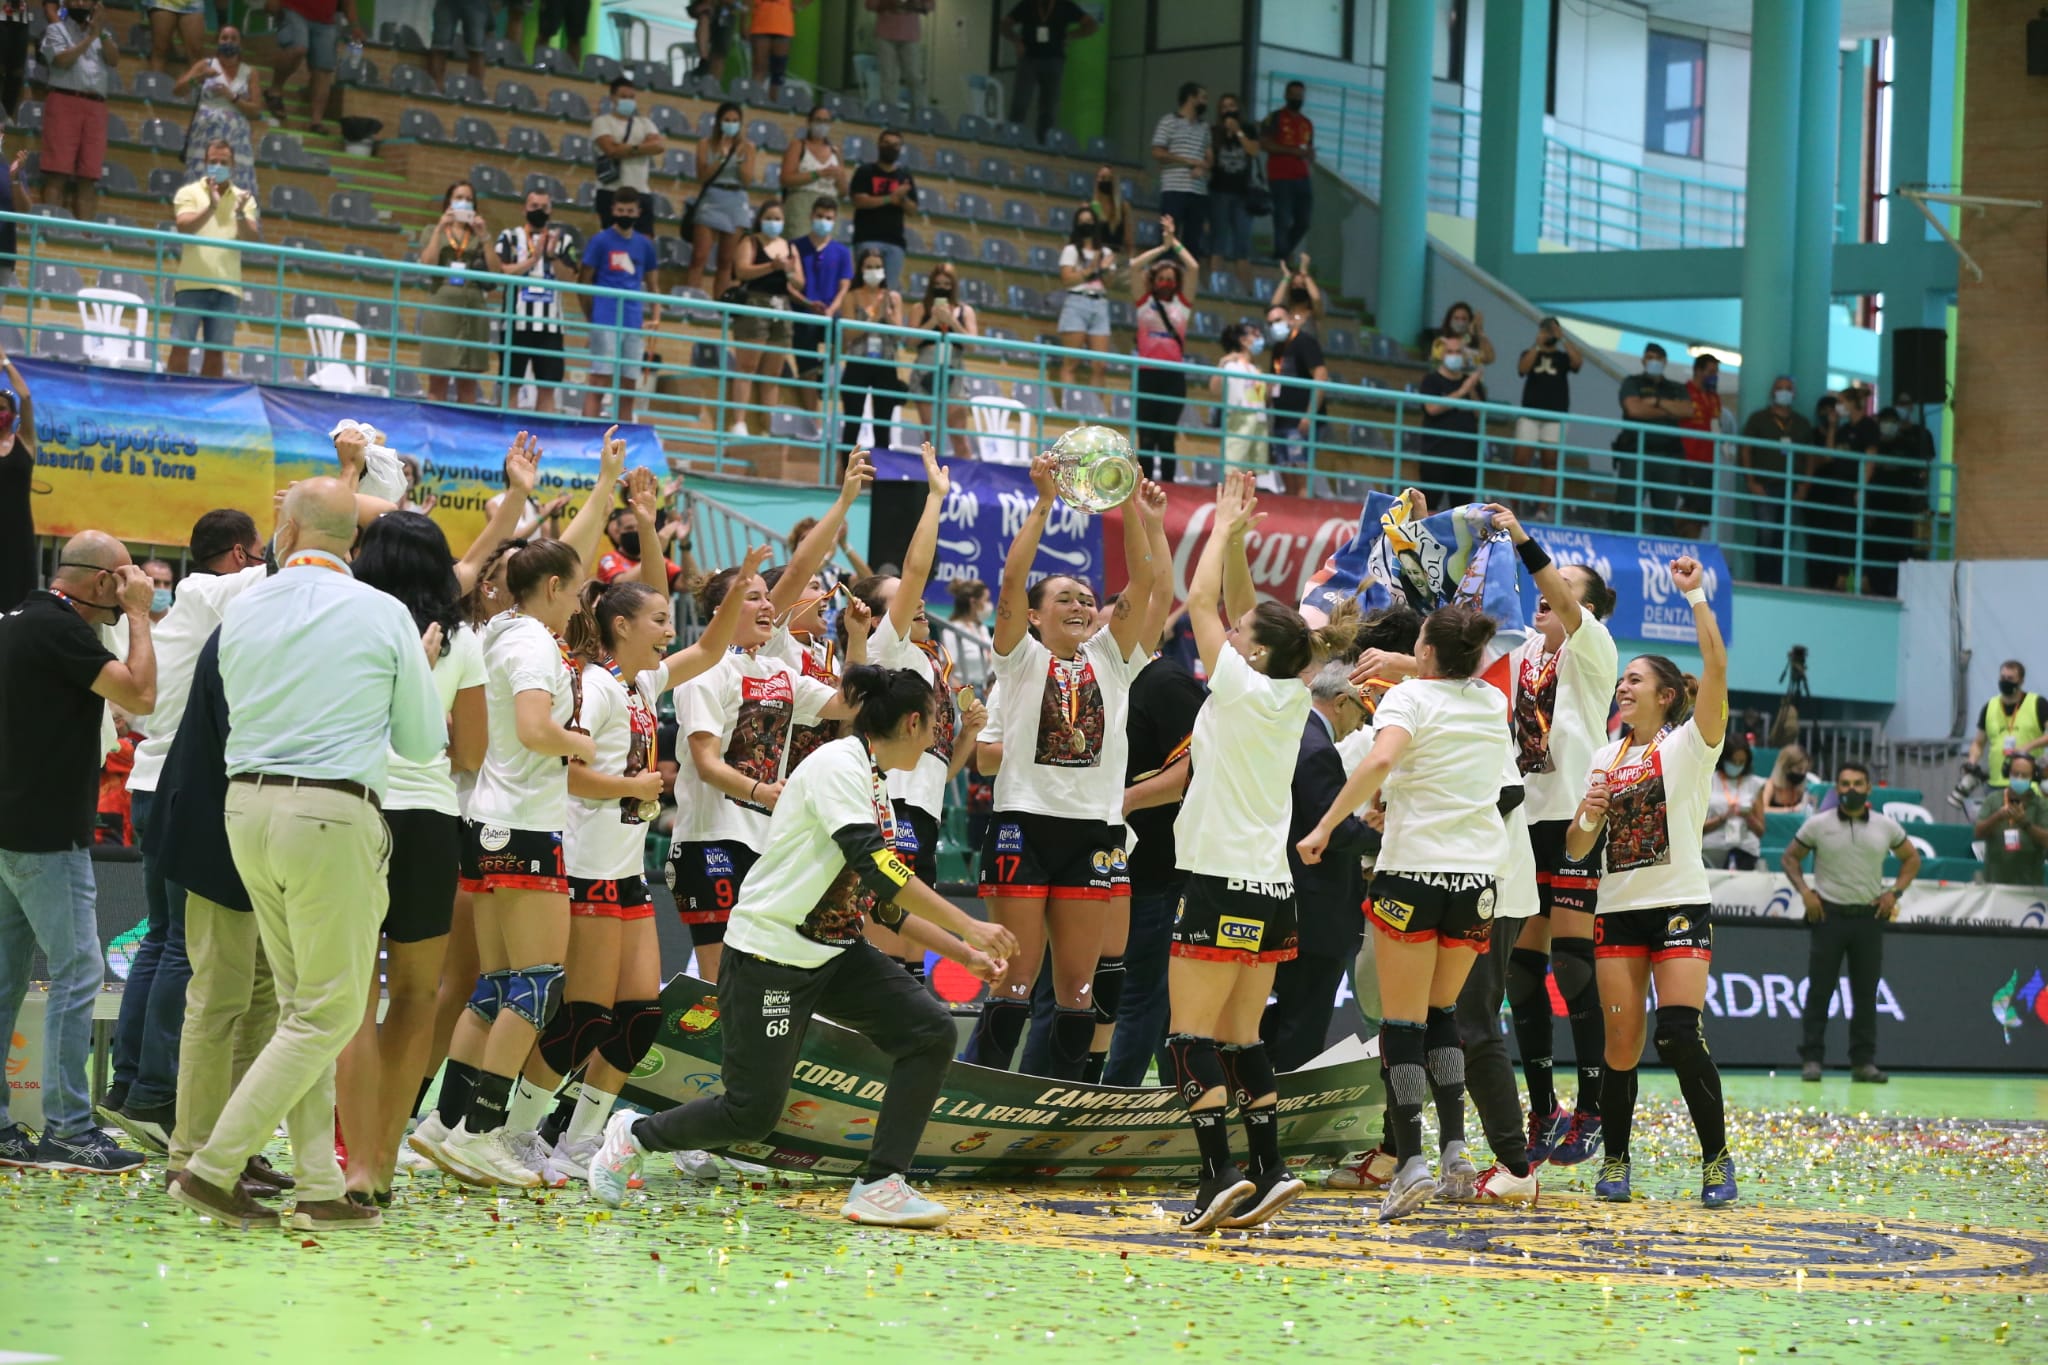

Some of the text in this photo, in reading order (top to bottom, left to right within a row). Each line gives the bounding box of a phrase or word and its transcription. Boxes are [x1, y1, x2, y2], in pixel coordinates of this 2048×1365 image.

[77, 415, 198, 456] Deportes
[101, 452, 123, 473] de
[130, 455, 145, 476] la
[152, 458, 196, 480] Torre
[995, 855, 1021, 883] 17
[586, 879, 618, 902] 28
[715, 878, 734, 908] 9
[766, 1018, 790, 1038] 68
[25, 1081, 41, 1089] SOL
[793, 1060, 860, 1095] COPA
[947, 1100, 986, 1119] LA
[982, 1105, 1059, 1126] REINA
